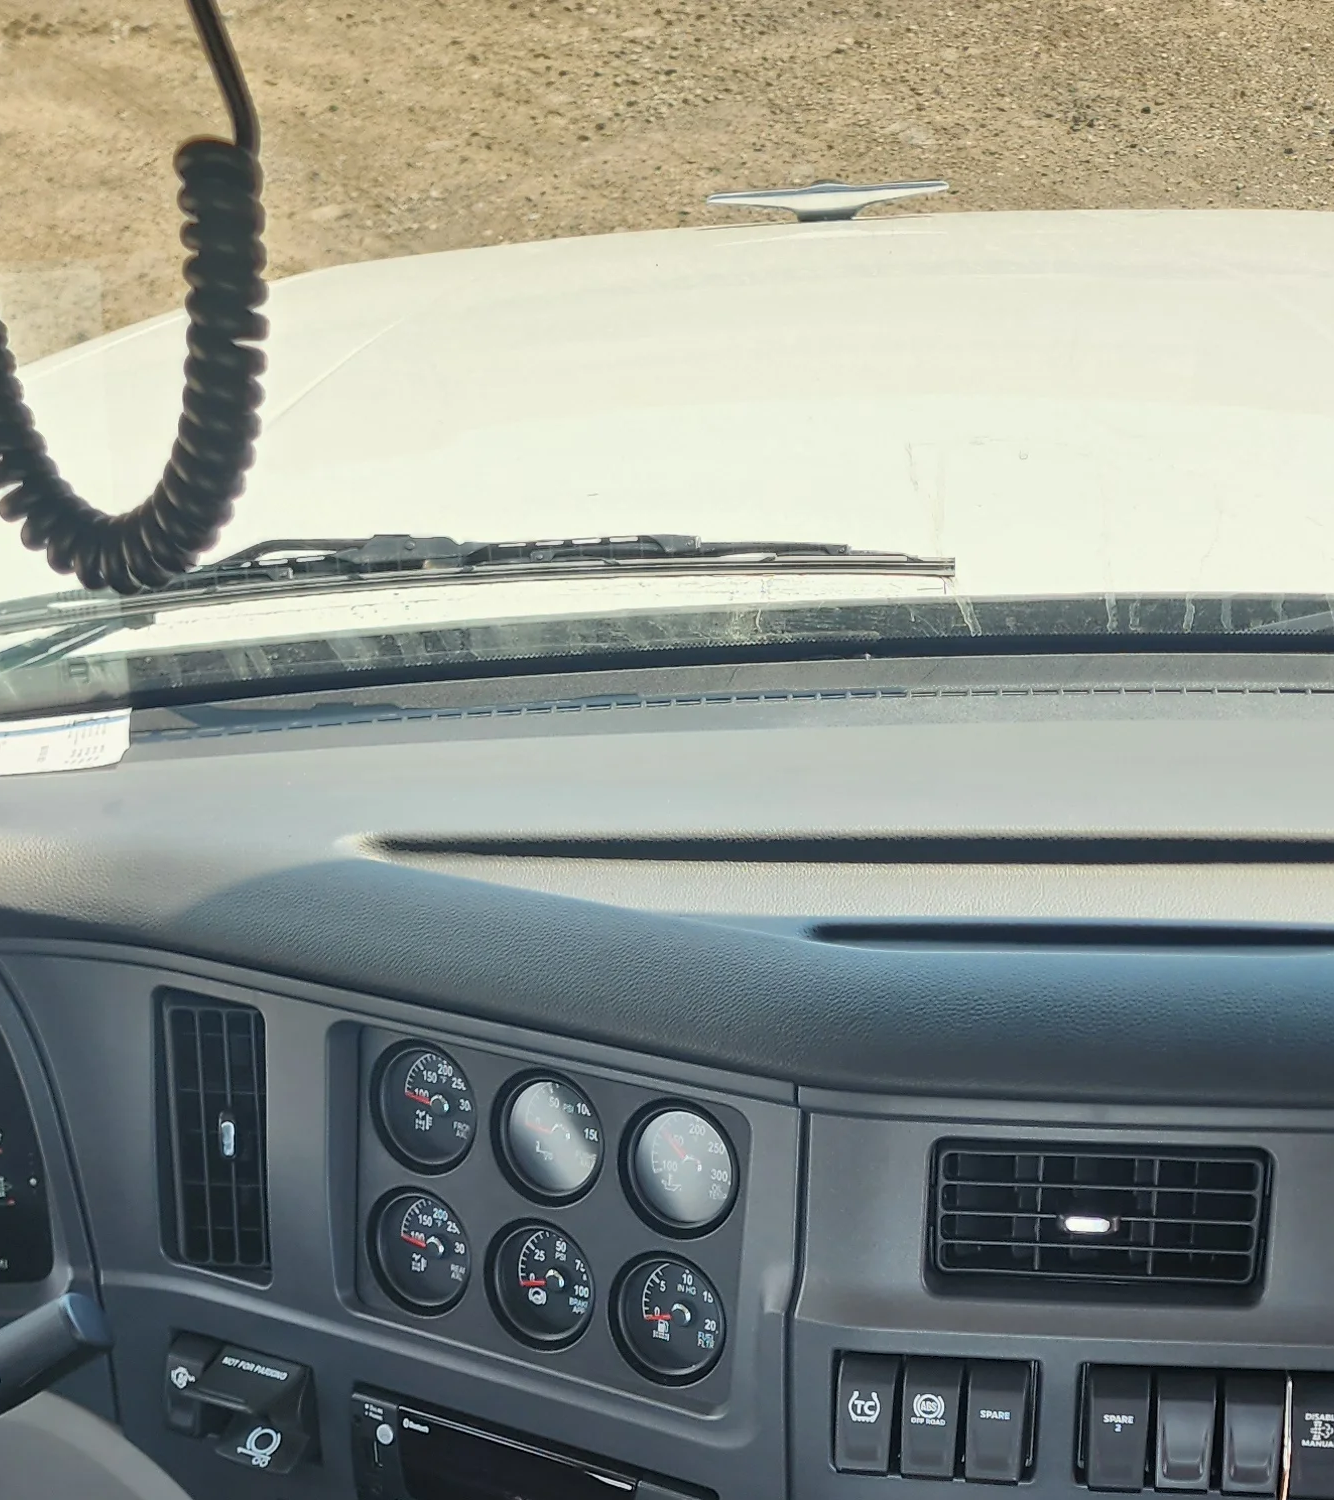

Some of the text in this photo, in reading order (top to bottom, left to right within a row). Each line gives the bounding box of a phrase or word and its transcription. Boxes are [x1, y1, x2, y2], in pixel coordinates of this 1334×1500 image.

[438, 1063, 453, 1077] 200
[423, 1070, 437, 1084] 150
[549, 1096, 559, 1108] 50
[689, 1123, 706, 1136] 200
[708, 1141, 725, 1155] 250
[663, 1159, 678, 1172] 100
[711, 1168, 728, 1182] 300
[418, 1214, 433, 1227] 150
[433, 1208, 449, 1221] 200
[555, 1240, 567, 1252] 50
[533, 1248, 545, 1262] 25
[682, 1272, 693, 1286] 10
[573, 1284, 589, 1298] 100
[660, 1280, 666, 1292] 5
[705, 1318, 717, 1332] 20
[222, 1356, 288, 1380] NOT FOR PARKING
[854, 1400, 875, 1415] TC
[920, 1400, 939, 1412] ABS
[979, 1409, 1011, 1420] SPARE
[1103, 1414, 1135, 1424] SPARE
[911, 1417, 945, 1426] OFF ROAD
[1115, 1424, 1122, 1432] 2
